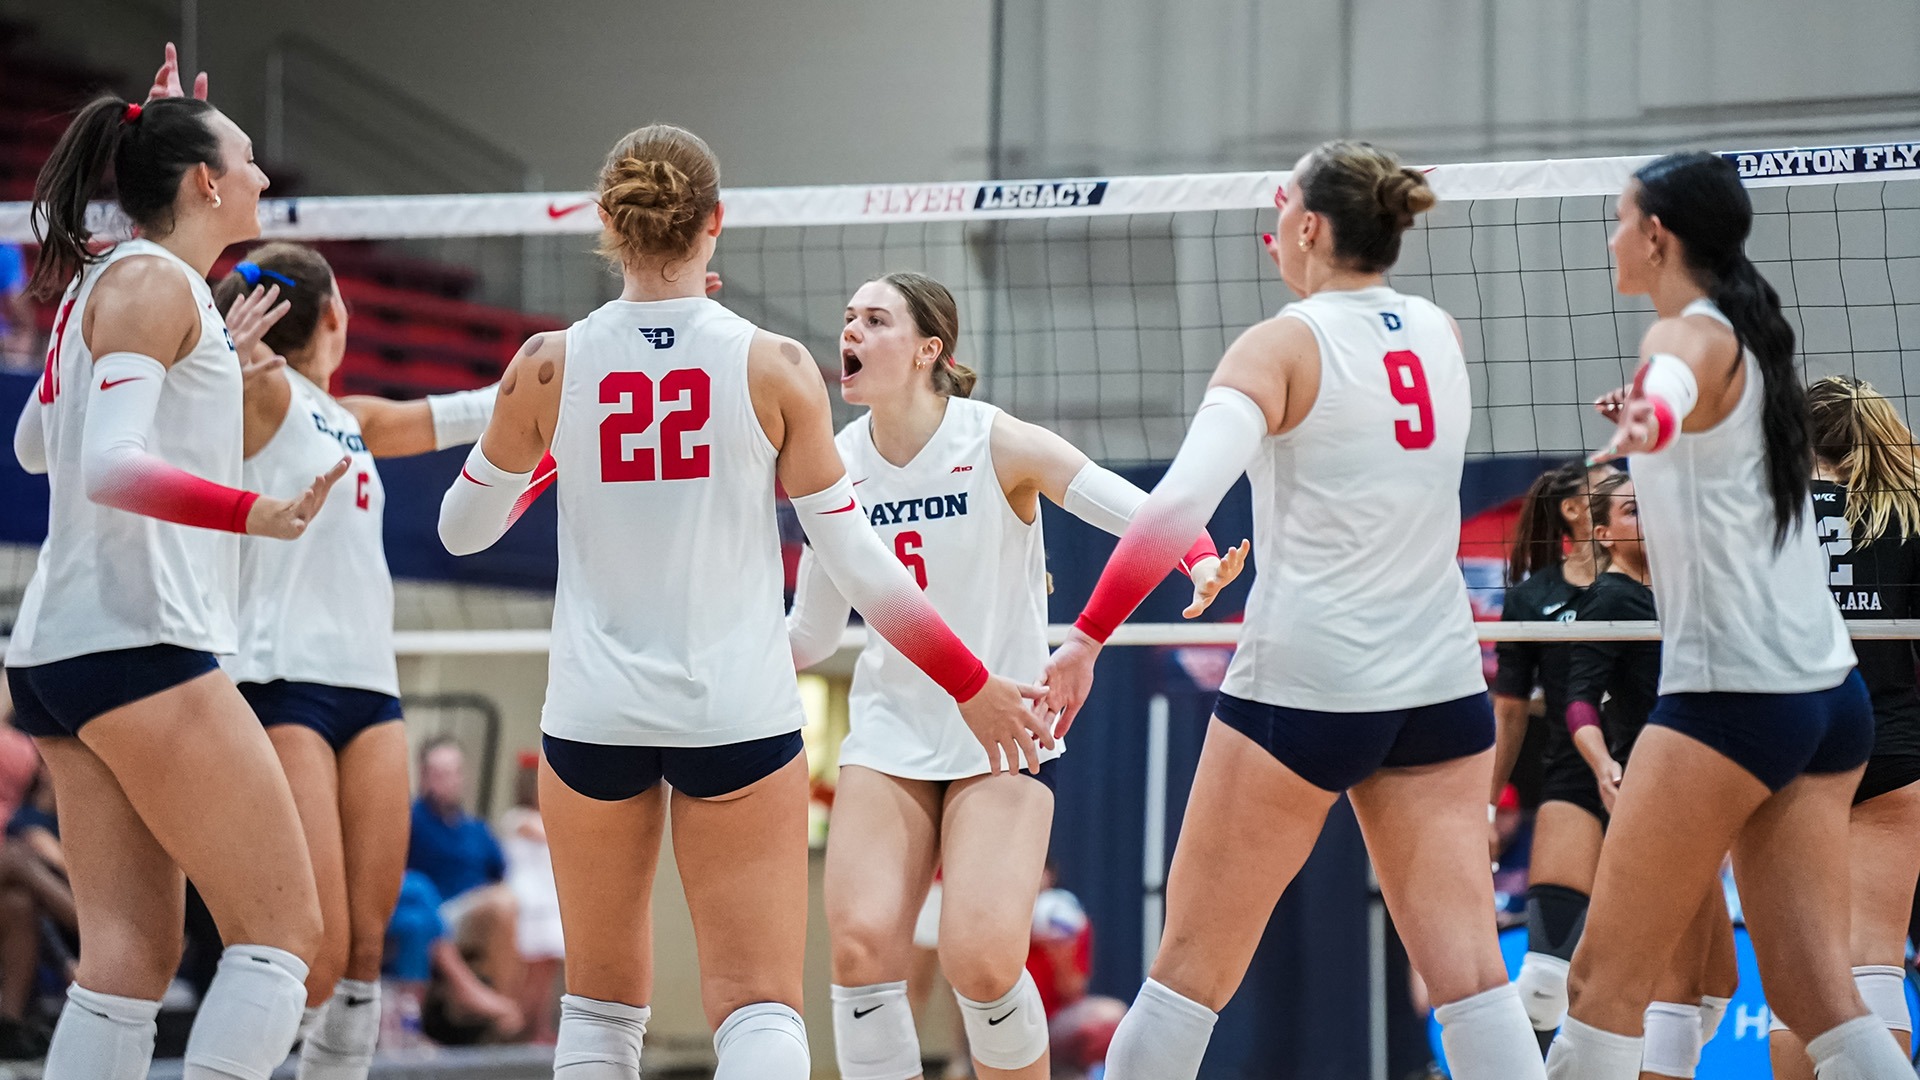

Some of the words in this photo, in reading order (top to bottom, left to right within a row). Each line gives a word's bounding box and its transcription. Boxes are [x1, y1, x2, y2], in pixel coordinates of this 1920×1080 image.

[1737, 149, 1856, 177] DAYTON
[863, 187, 966, 214] FLYER
[981, 183, 1098, 208] LEGACY
[1383, 350, 1436, 450] 9
[599, 368, 711, 482] 22
[862, 492, 968, 526] AYTON
[894, 530, 928, 592] 6
